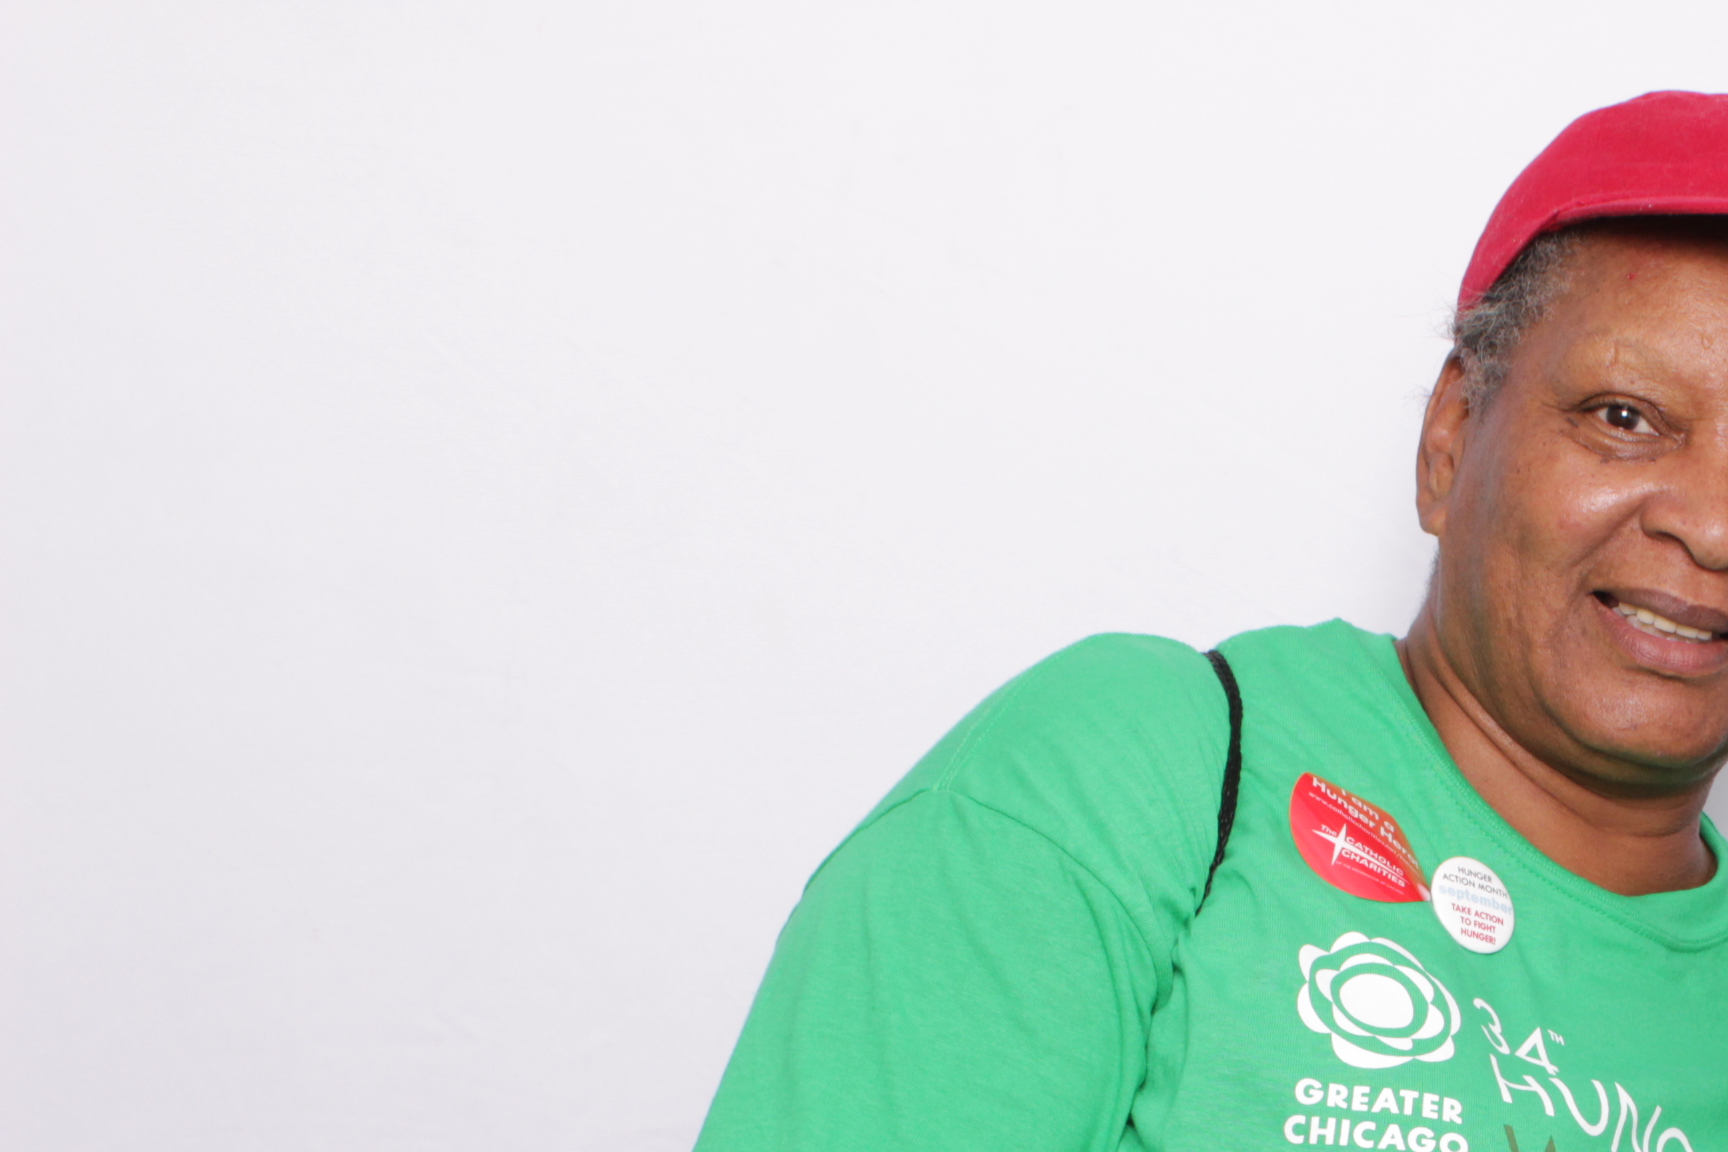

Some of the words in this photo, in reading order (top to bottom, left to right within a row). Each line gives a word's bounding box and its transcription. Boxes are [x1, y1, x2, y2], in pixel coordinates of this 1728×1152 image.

[1312, 776, 1376, 828] Hunger
[1351, 796, 1380, 820] am
[1384, 820, 1395, 833] a
[1321, 823, 1338, 837] The
[1341, 848, 1407, 887] CHARITIES
[1346, 836, 1404, 876] CATHOLIC
[1443, 873, 1475, 889] ACTION
[1478, 882, 1508, 899] MONTH
[1458, 866, 1492, 883] HUNGER
[1439, 885, 1512, 915] september
[1451, 902, 1472, 916] TAKE
[1474, 910, 1504, 926] ACTION
[1460, 916, 1472, 926] TO
[1473, 920, 1497, 934] FIGHT
[1460, 927, 1497, 946] HUNGER!
[1294, 1077, 1463, 1125] GREATER
